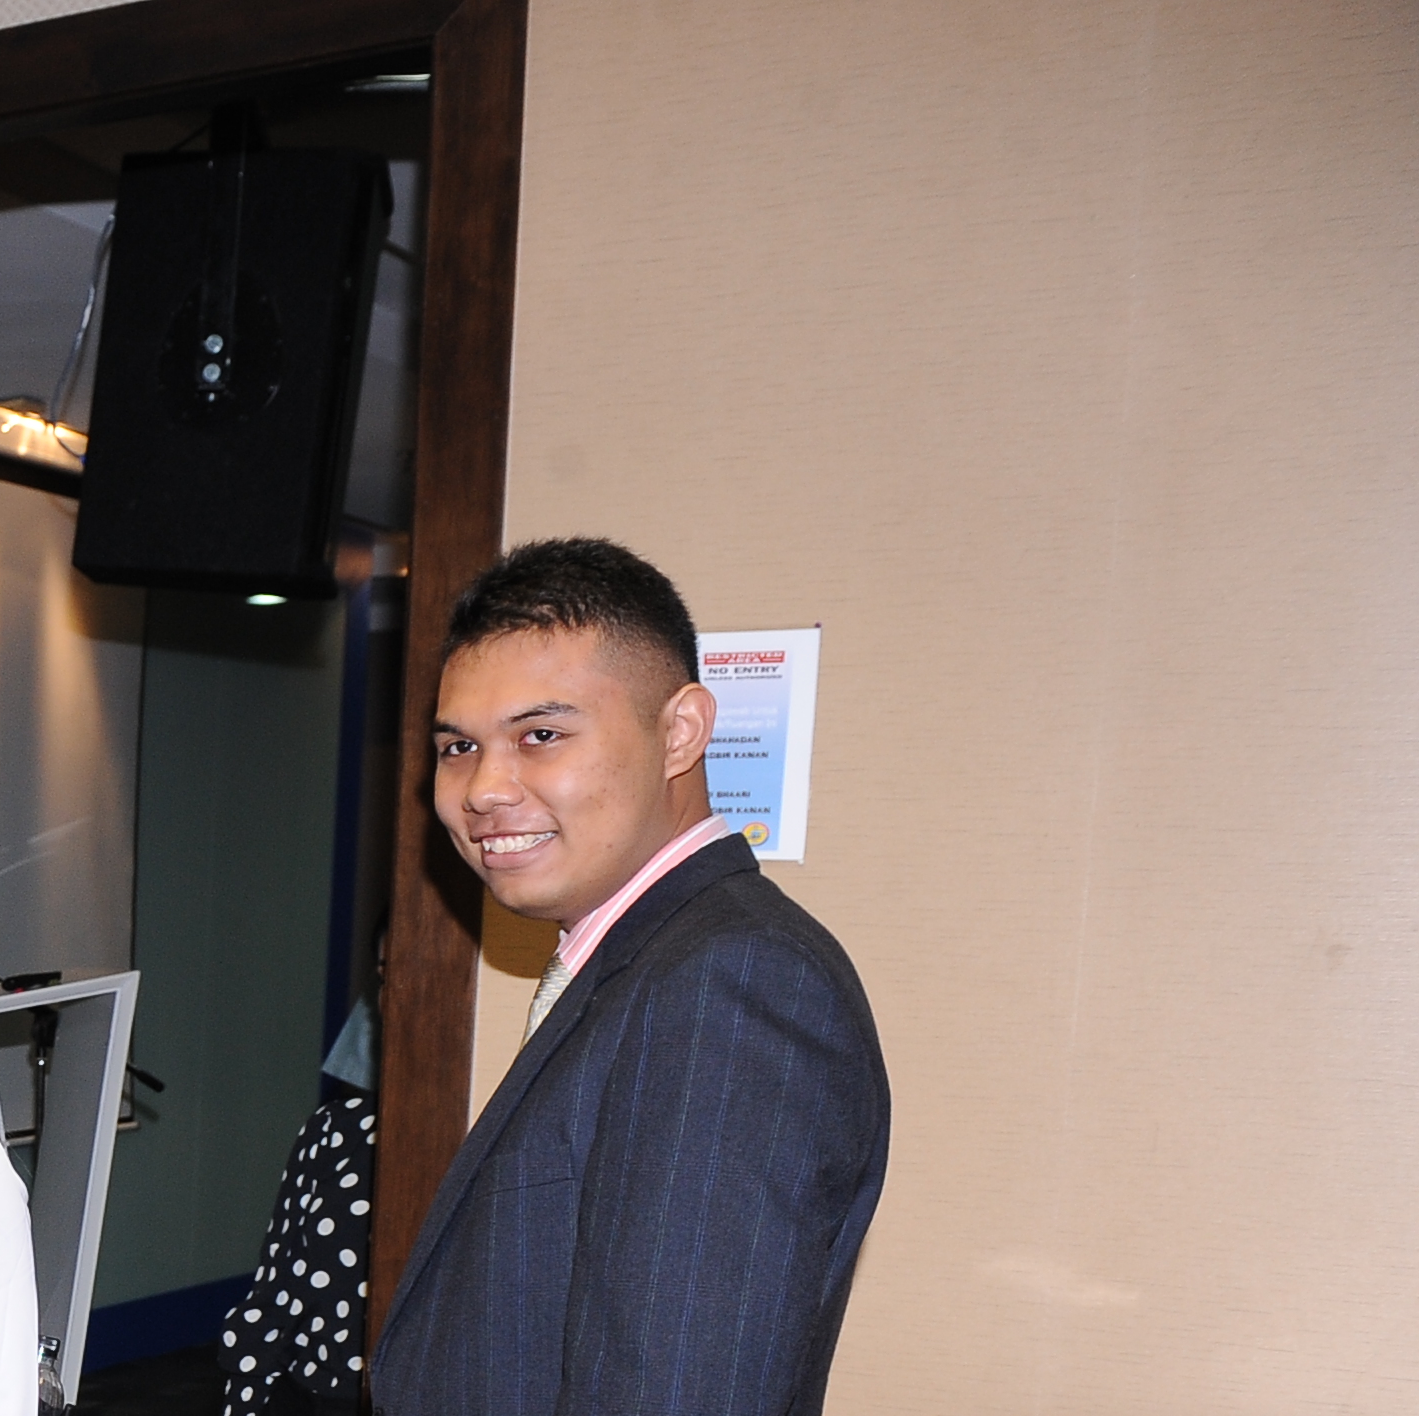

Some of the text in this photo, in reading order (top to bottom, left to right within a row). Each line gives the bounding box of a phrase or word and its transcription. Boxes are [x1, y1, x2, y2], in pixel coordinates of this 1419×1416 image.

[708, 665, 780, 675] NO ENTRY
[736, 806, 771, 814] KANAN
